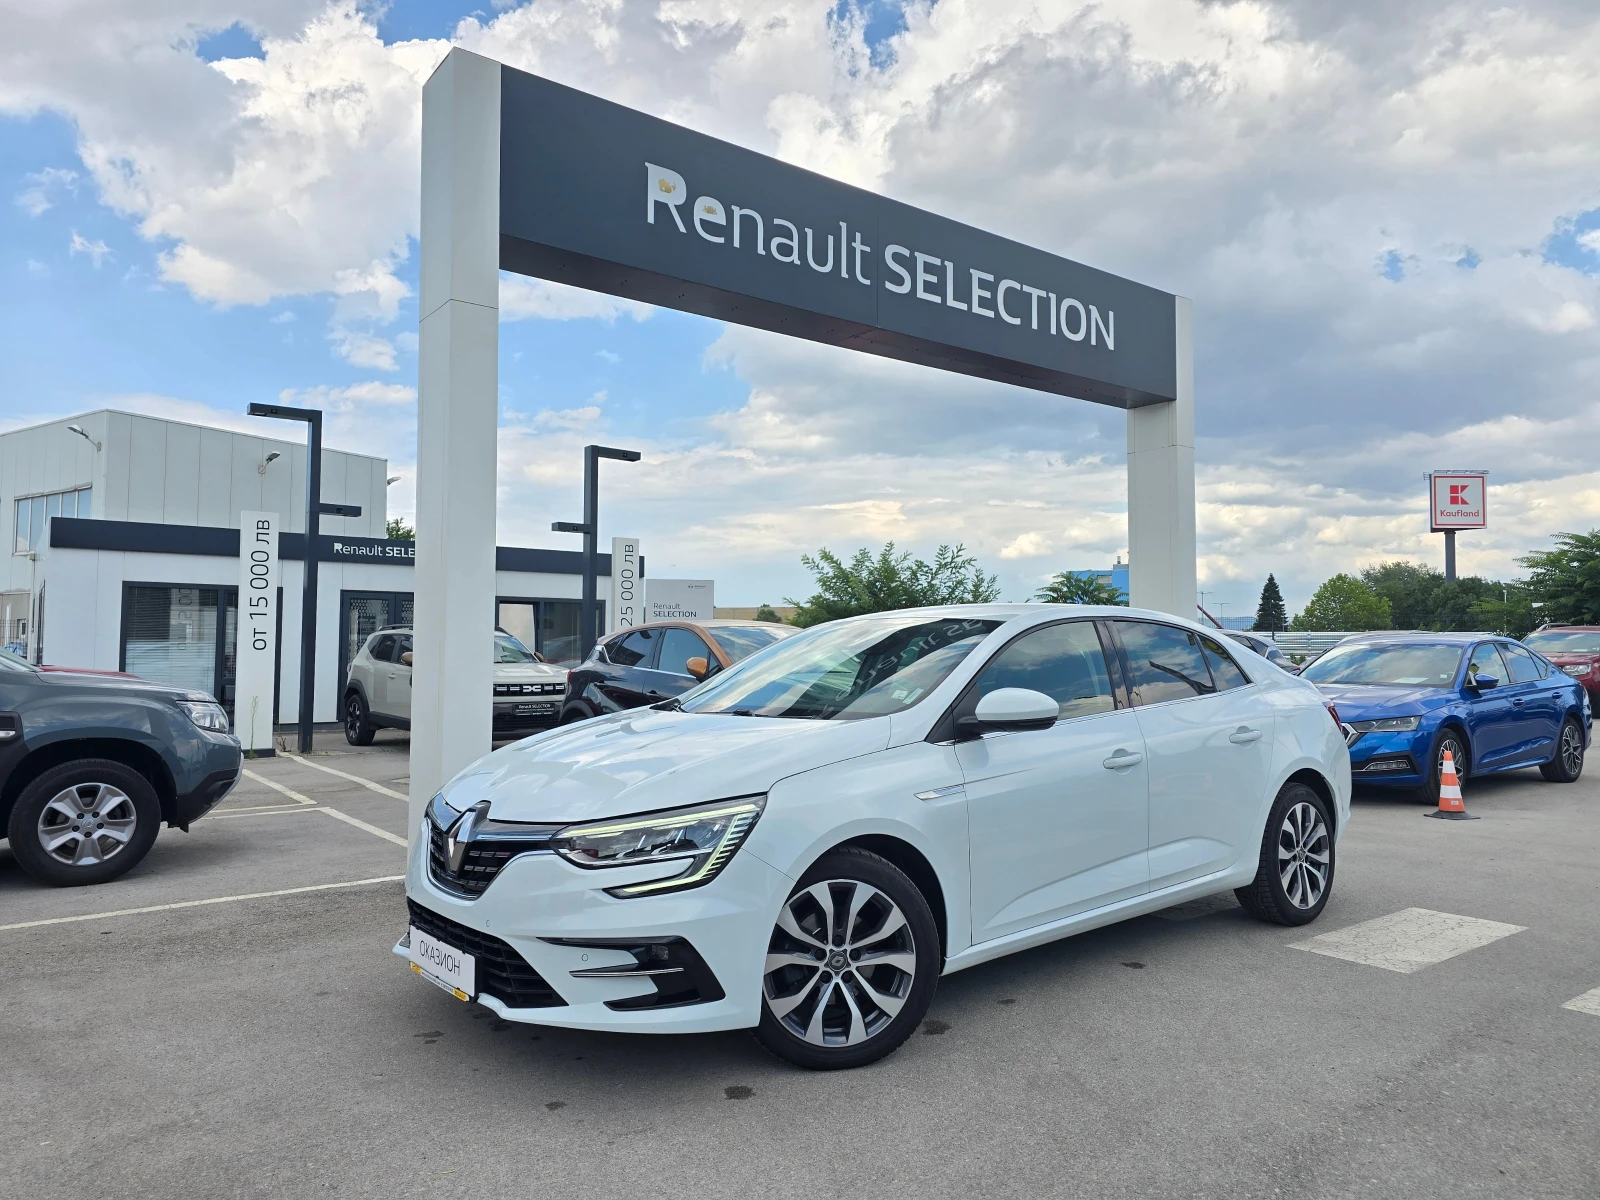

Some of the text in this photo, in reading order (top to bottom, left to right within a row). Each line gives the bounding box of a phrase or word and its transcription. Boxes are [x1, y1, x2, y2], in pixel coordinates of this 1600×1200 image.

[644, 161, 1117, 351] Renault SELECTION
[1440, 509, 1479, 517] Kaufland
[333, 543, 383, 556] Renault
[250, 550, 270, 590] 000
[621, 568, 634, 601] 000
[249, 596, 268, 620] 15
[621, 606, 634, 626] 25
[653, 602, 681, 610] Renault
[653, 610, 697, 618] SELECTION
[419, 940, 461, 977] ОКАЗИОН
